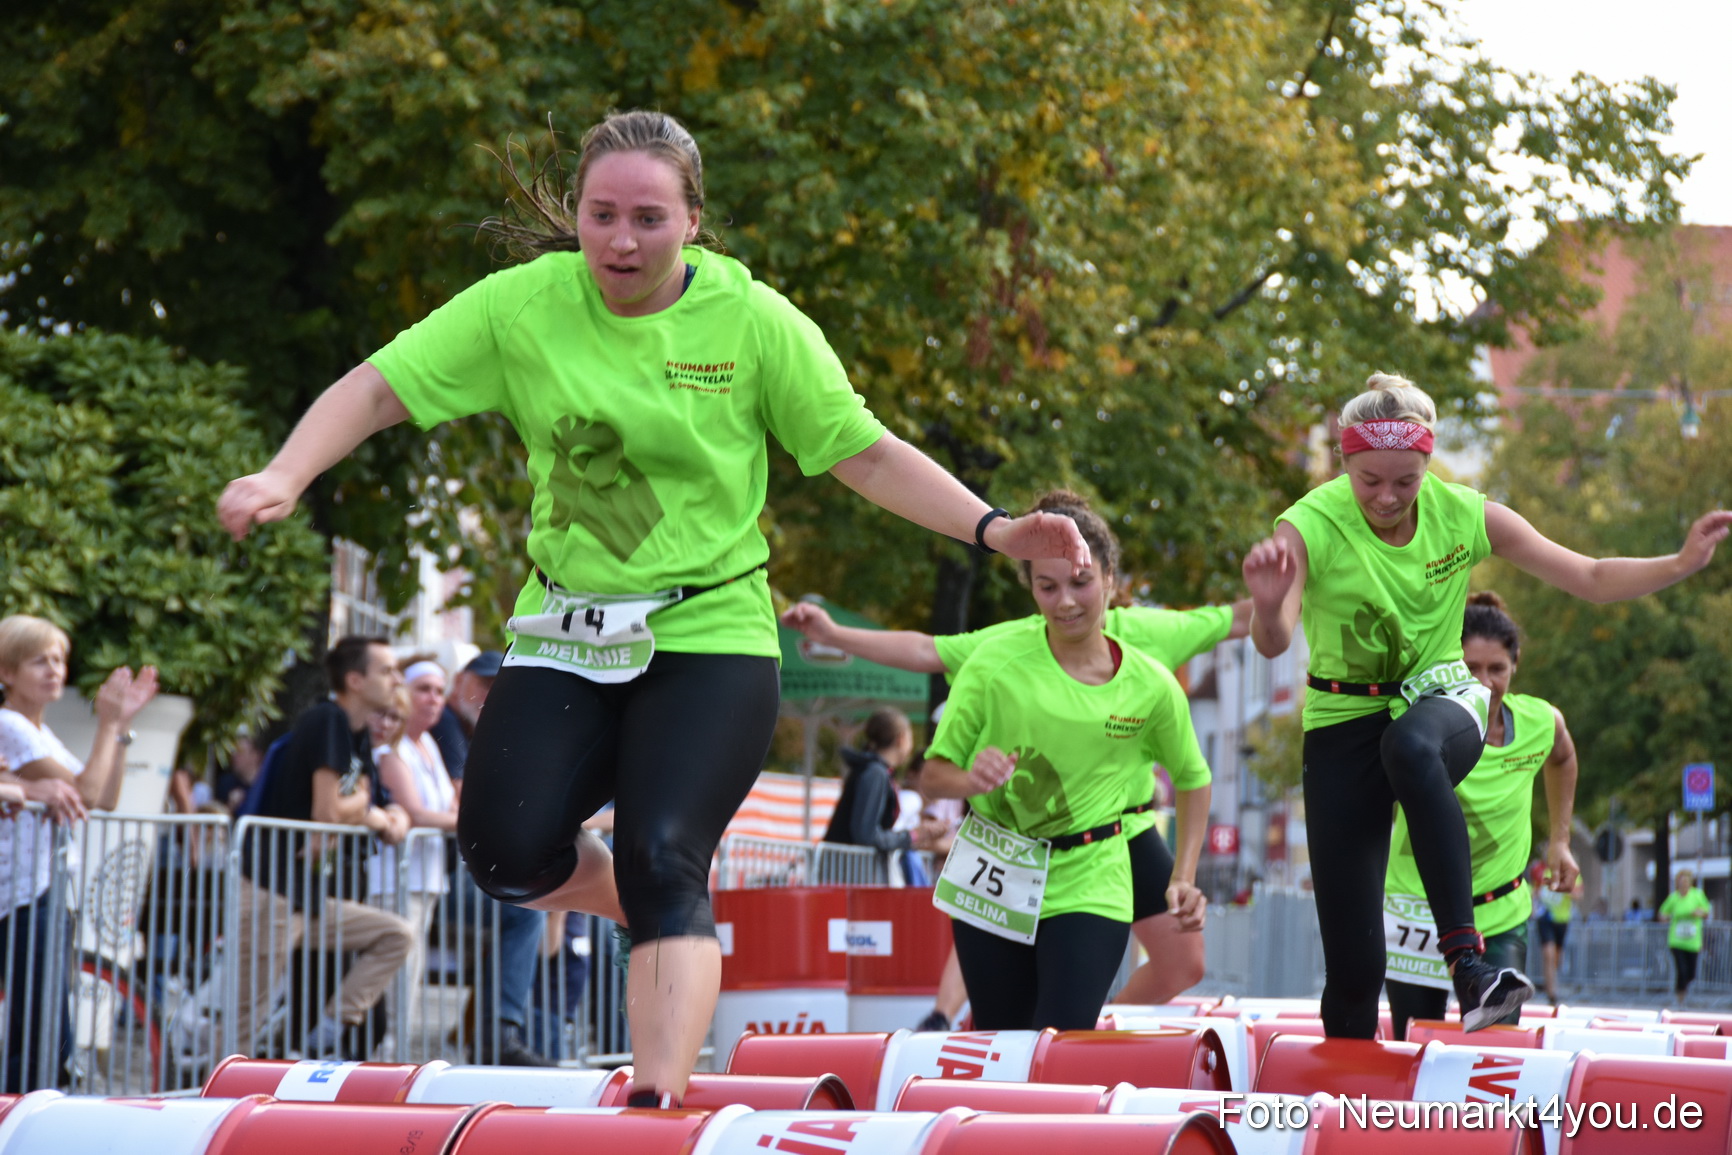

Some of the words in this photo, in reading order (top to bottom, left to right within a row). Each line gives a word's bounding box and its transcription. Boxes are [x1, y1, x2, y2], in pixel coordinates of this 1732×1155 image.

[536, 641, 631, 666] MELANIE
[966, 815, 1037, 867] BOCK
[970, 856, 1005, 897] 75
[955, 891, 1008, 926] SELINA
[1397, 924, 1431, 952] 77
[1388, 955, 1449, 979] ANUELA
